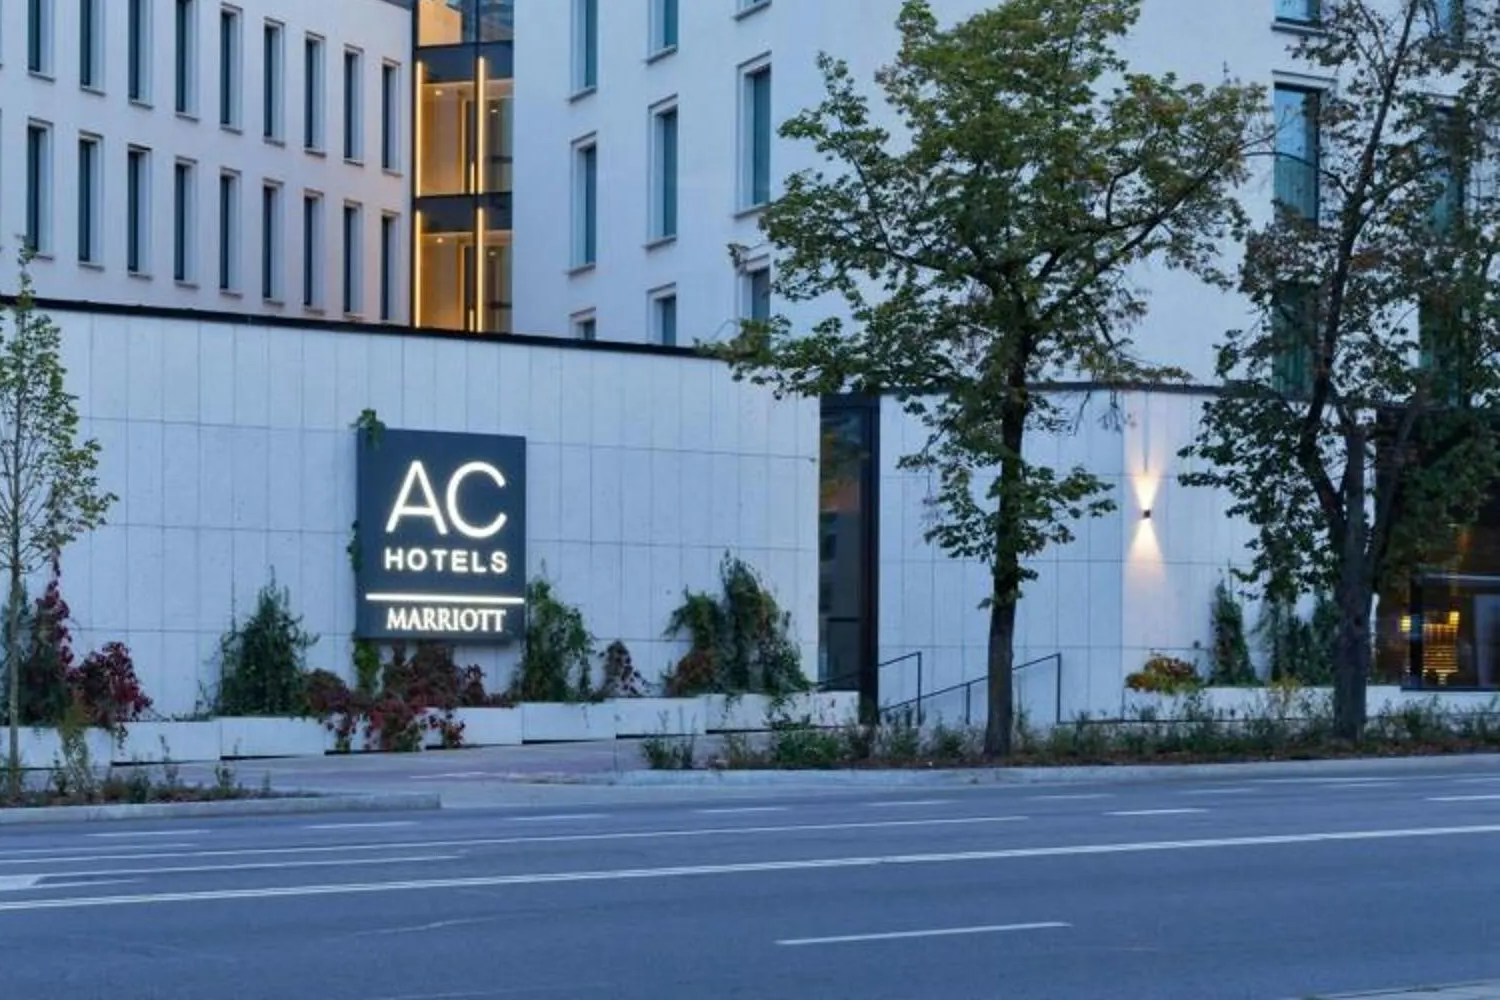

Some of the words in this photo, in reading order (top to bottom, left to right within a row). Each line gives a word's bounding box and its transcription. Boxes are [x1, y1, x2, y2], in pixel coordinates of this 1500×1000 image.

[385, 460, 507, 539] AC
[384, 547, 508, 574] HOTELS
[386, 606, 507, 632] MARRIOTT
